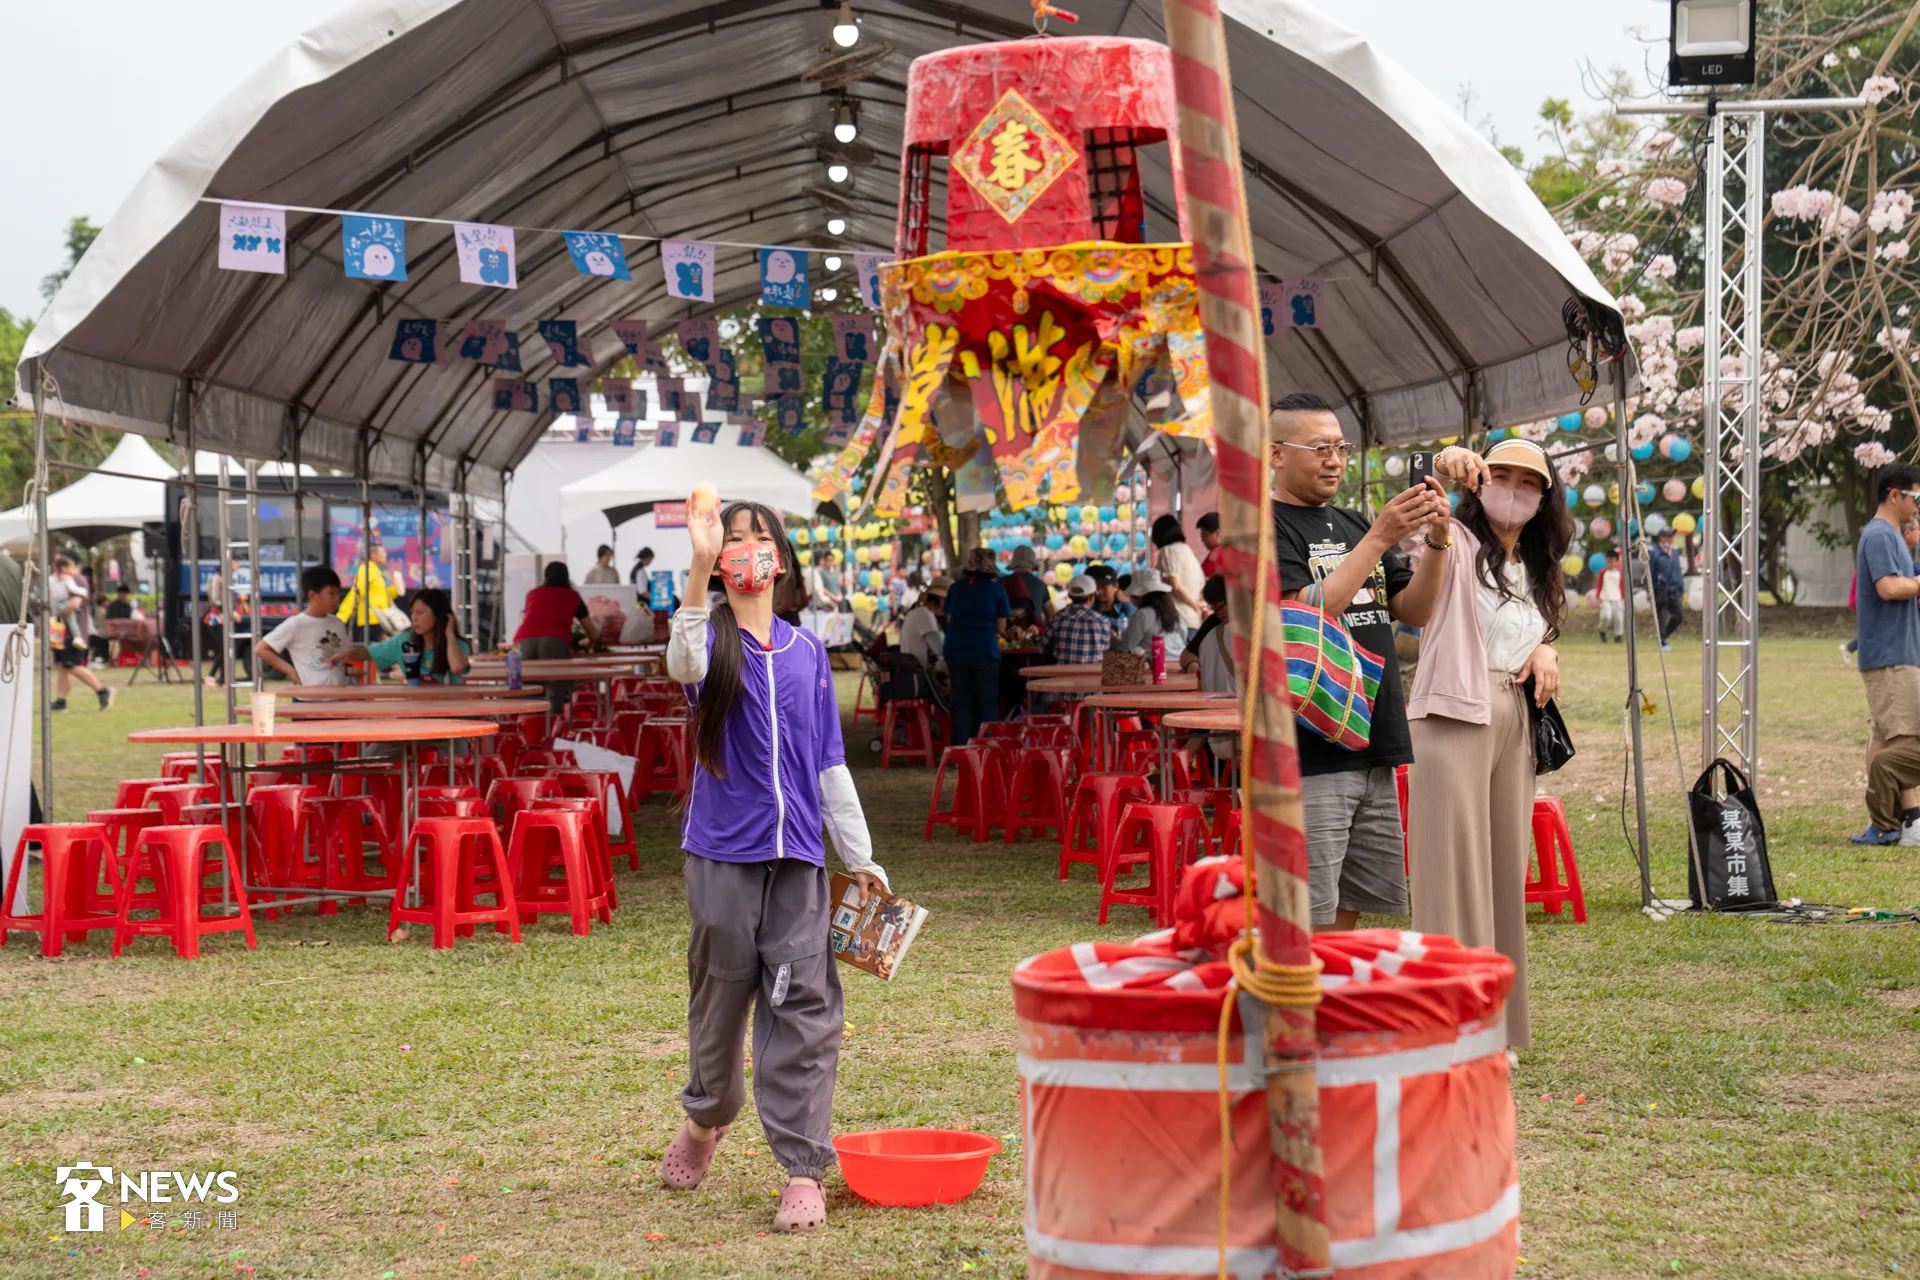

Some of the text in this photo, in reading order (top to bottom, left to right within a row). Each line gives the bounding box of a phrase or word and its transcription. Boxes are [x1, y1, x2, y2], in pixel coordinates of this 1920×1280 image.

[1701, 64, 1723, 76] LED
[986, 119, 1043, 189] 春
[1720, 808, 1750, 897] 某某市集
